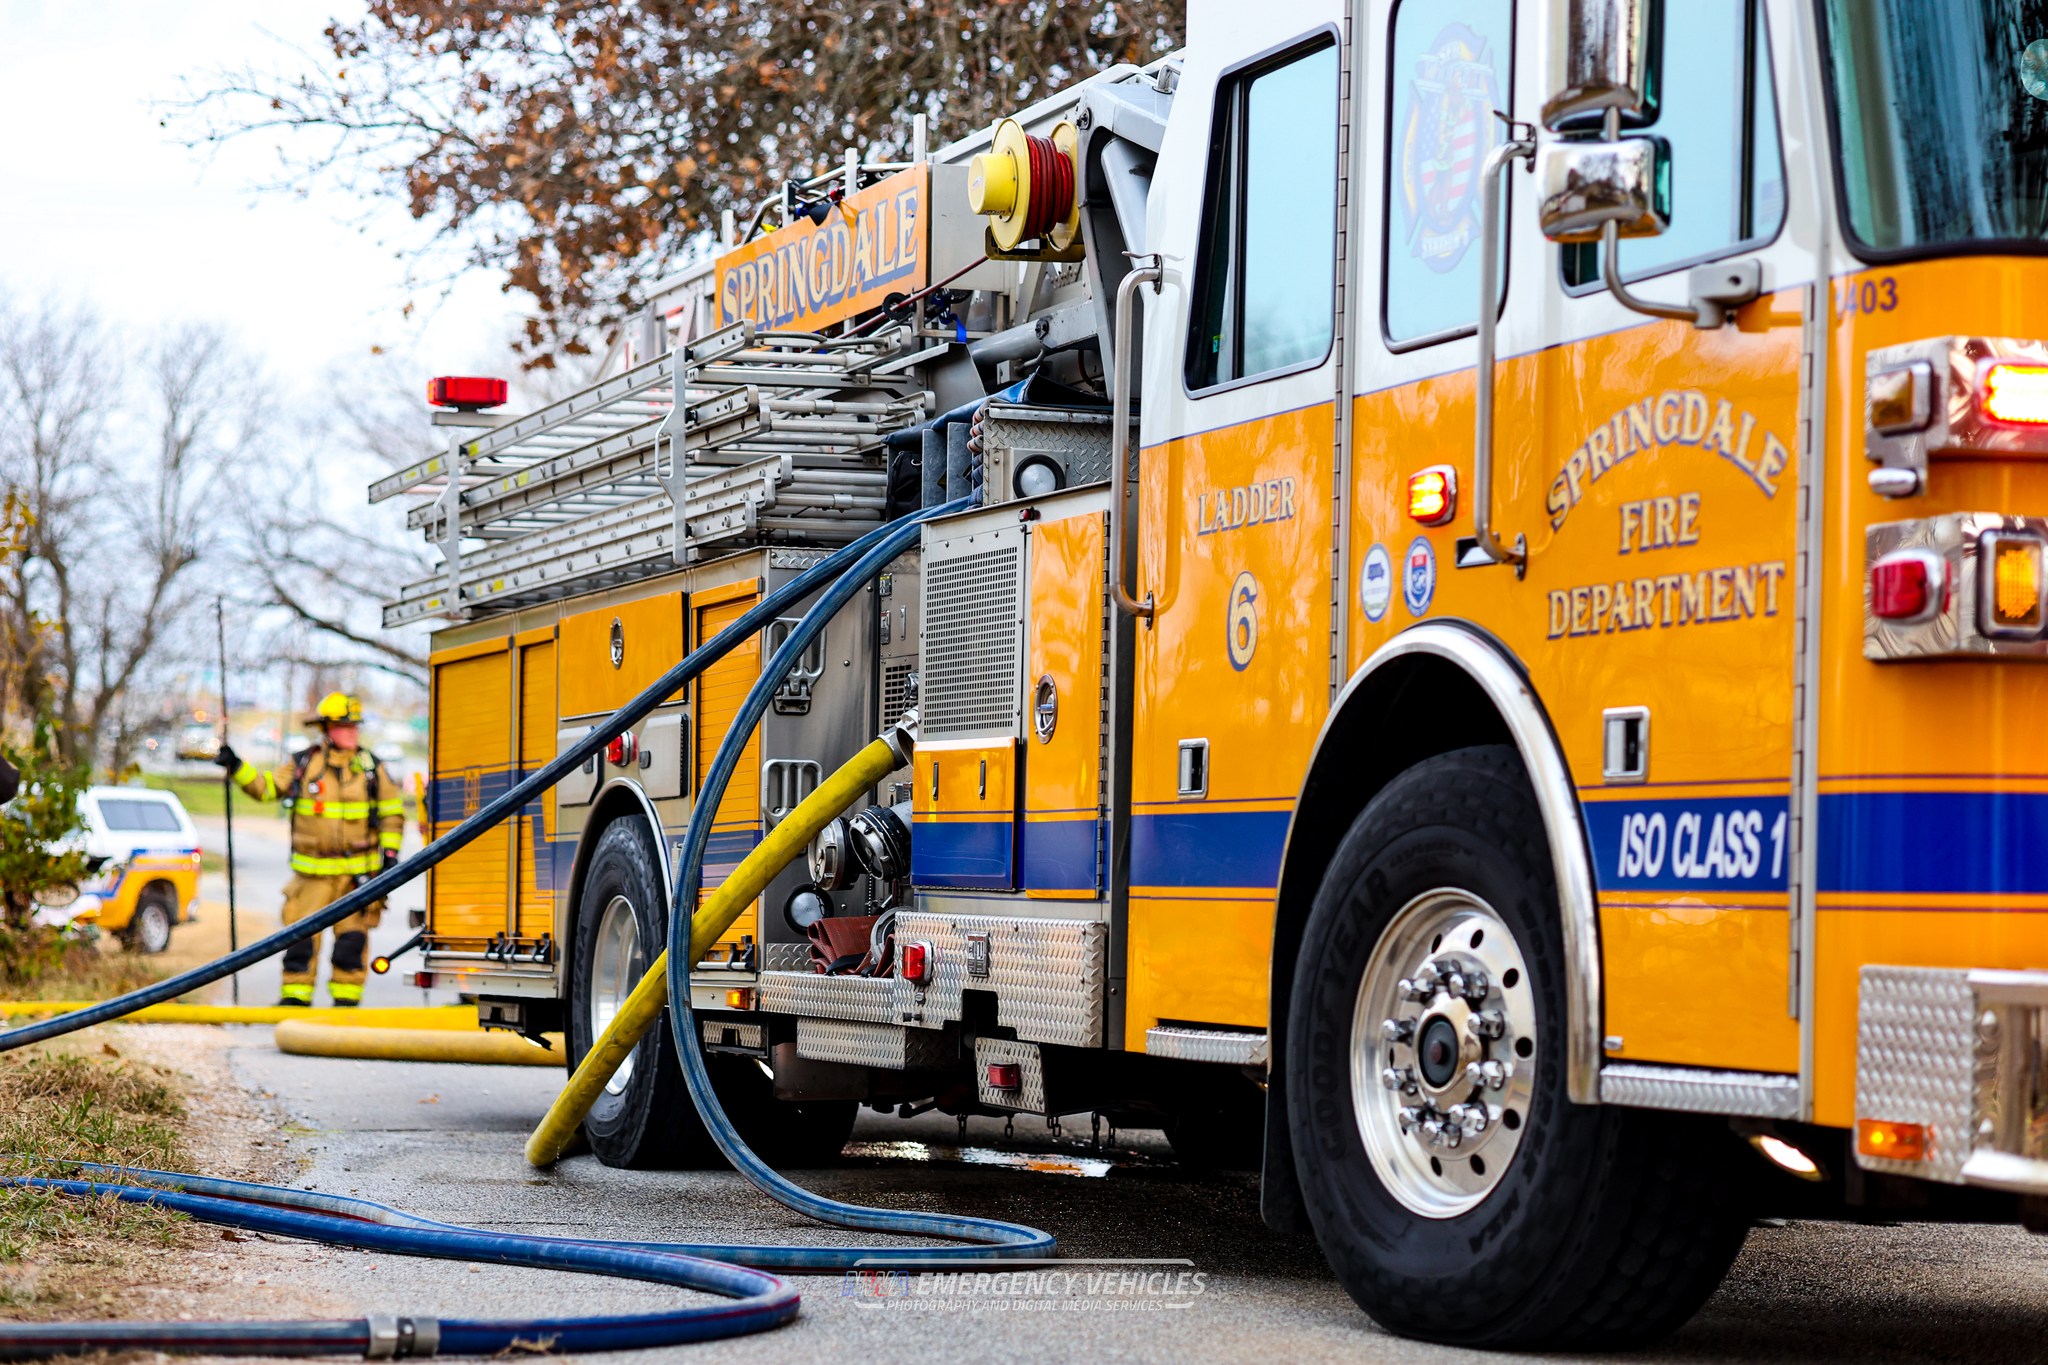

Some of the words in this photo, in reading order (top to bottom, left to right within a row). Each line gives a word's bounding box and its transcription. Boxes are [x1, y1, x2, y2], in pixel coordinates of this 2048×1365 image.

[721, 186, 918, 332] SPRINGDALE
[1197, 476, 1296, 536] LADDER
[1546, 390, 1789, 533] SPRINGDALE
[1618, 491, 1700, 555] FIRE
[1227, 571, 1258, 672] 6
[1547, 560, 1785, 640] DEPARTMENT
[1617, 811, 1667, 878] ISO
[1671, 810, 1763, 878] CLASS
[1770, 811, 1787, 878] 1
[1312, 868, 1392, 1162] GOODYEAR
